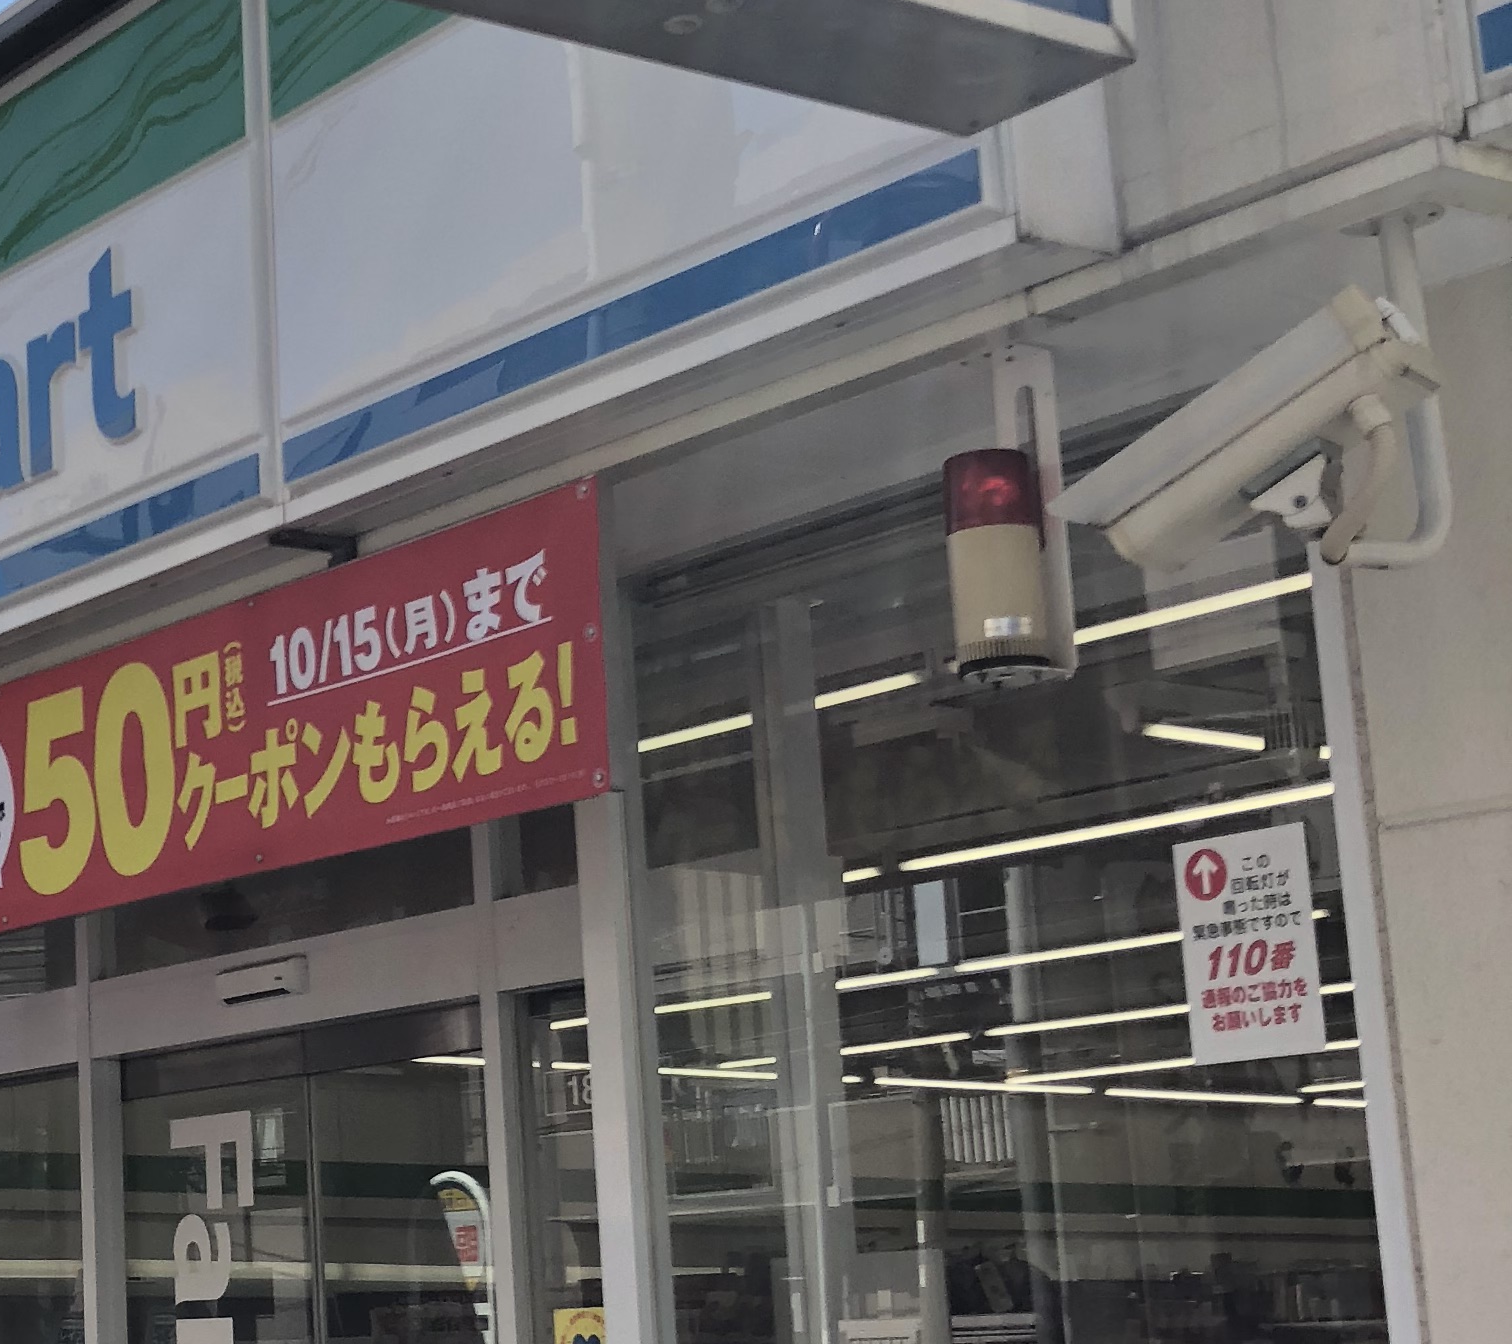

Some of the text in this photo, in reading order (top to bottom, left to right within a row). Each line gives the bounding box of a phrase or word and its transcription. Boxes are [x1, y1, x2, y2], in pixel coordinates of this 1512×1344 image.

[268, 549, 548, 697] 10/15(月)まで
[177, 641, 580, 851] クーポンもらえる!
[1241, 854, 1271, 872] この
[1231, 869, 1291, 895] 回転灯が
[1208, 939, 1296, 981] 110番
[1201, 978, 1308, 1009] 通報のご協力を
[1211, 1003, 1303, 1033] お願いします
